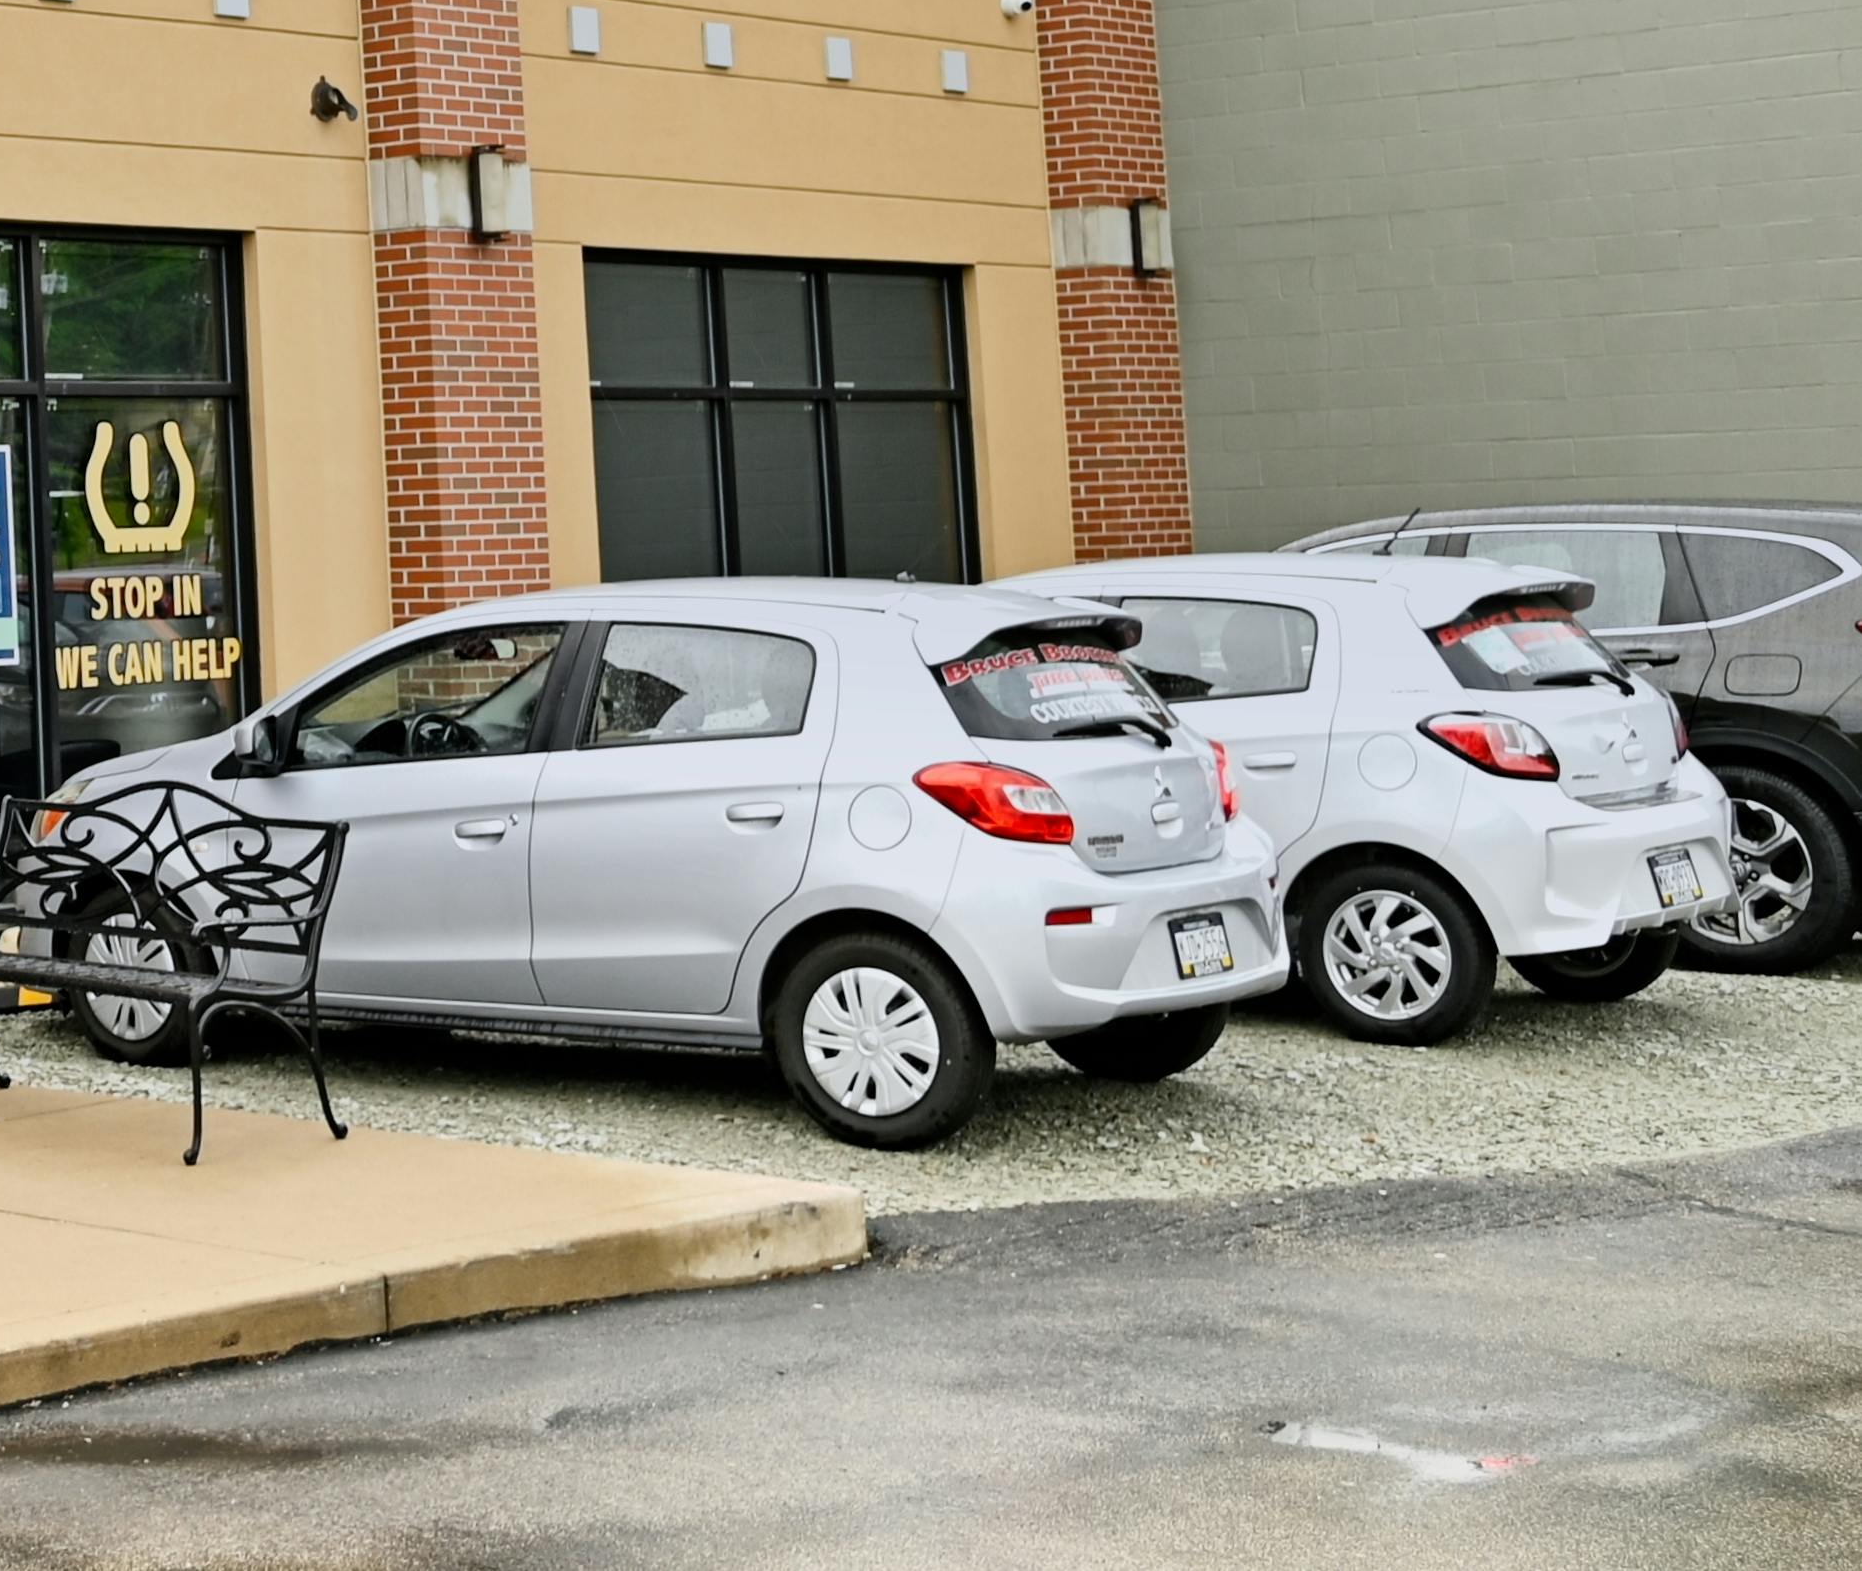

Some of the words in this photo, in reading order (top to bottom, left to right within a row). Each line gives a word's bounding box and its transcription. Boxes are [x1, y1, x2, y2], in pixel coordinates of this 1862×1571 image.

[89, 575, 164, 621] STOP
[172, 574, 203, 617] IN
[55, 645, 100, 691] WE
[107, 640, 164, 687] CAN
[171, 636, 241, 682] HELP
[941, 647, 1039, 688] BRUCE
